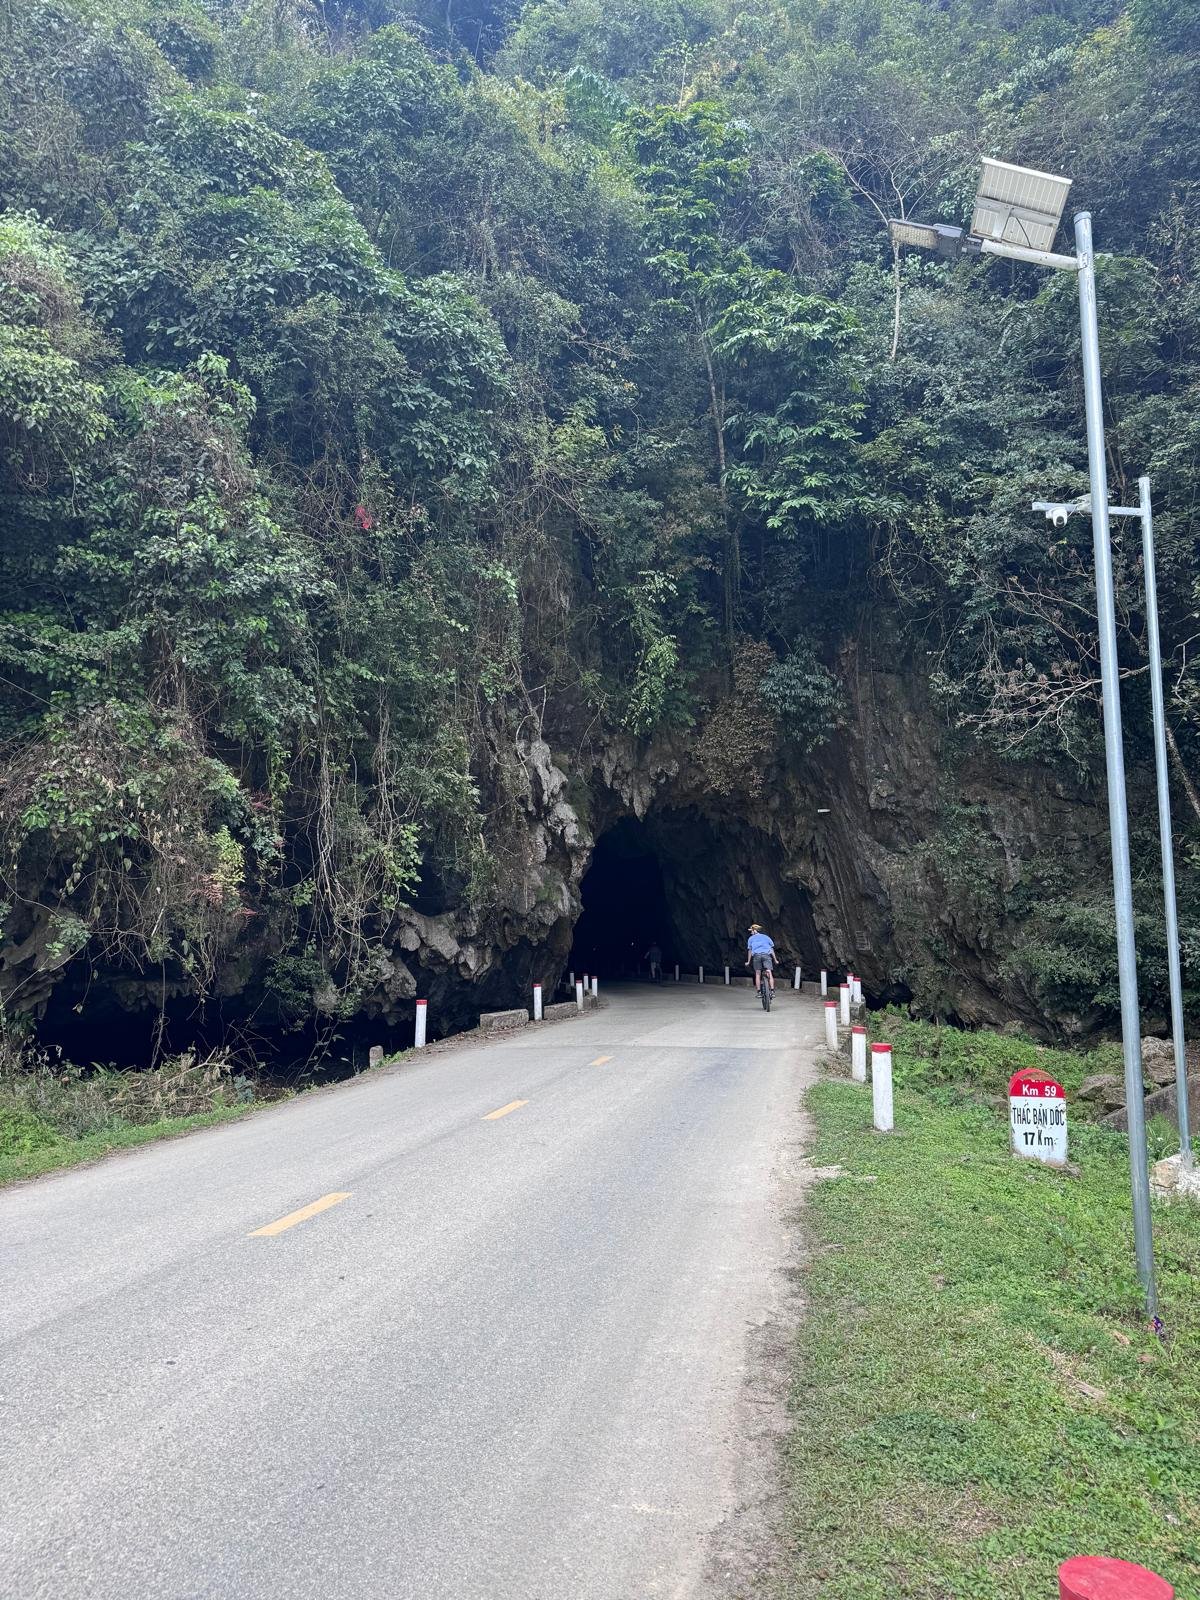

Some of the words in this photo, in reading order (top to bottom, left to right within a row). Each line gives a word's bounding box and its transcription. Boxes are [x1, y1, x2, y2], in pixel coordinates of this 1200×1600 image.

[1022, 1084, 1038, 1096] Km
[1045, 1085, 1056, 1096] 59
[1023, 1132, 1035, 1146] 17
[1038, 1130, 1053, 1146] Km
